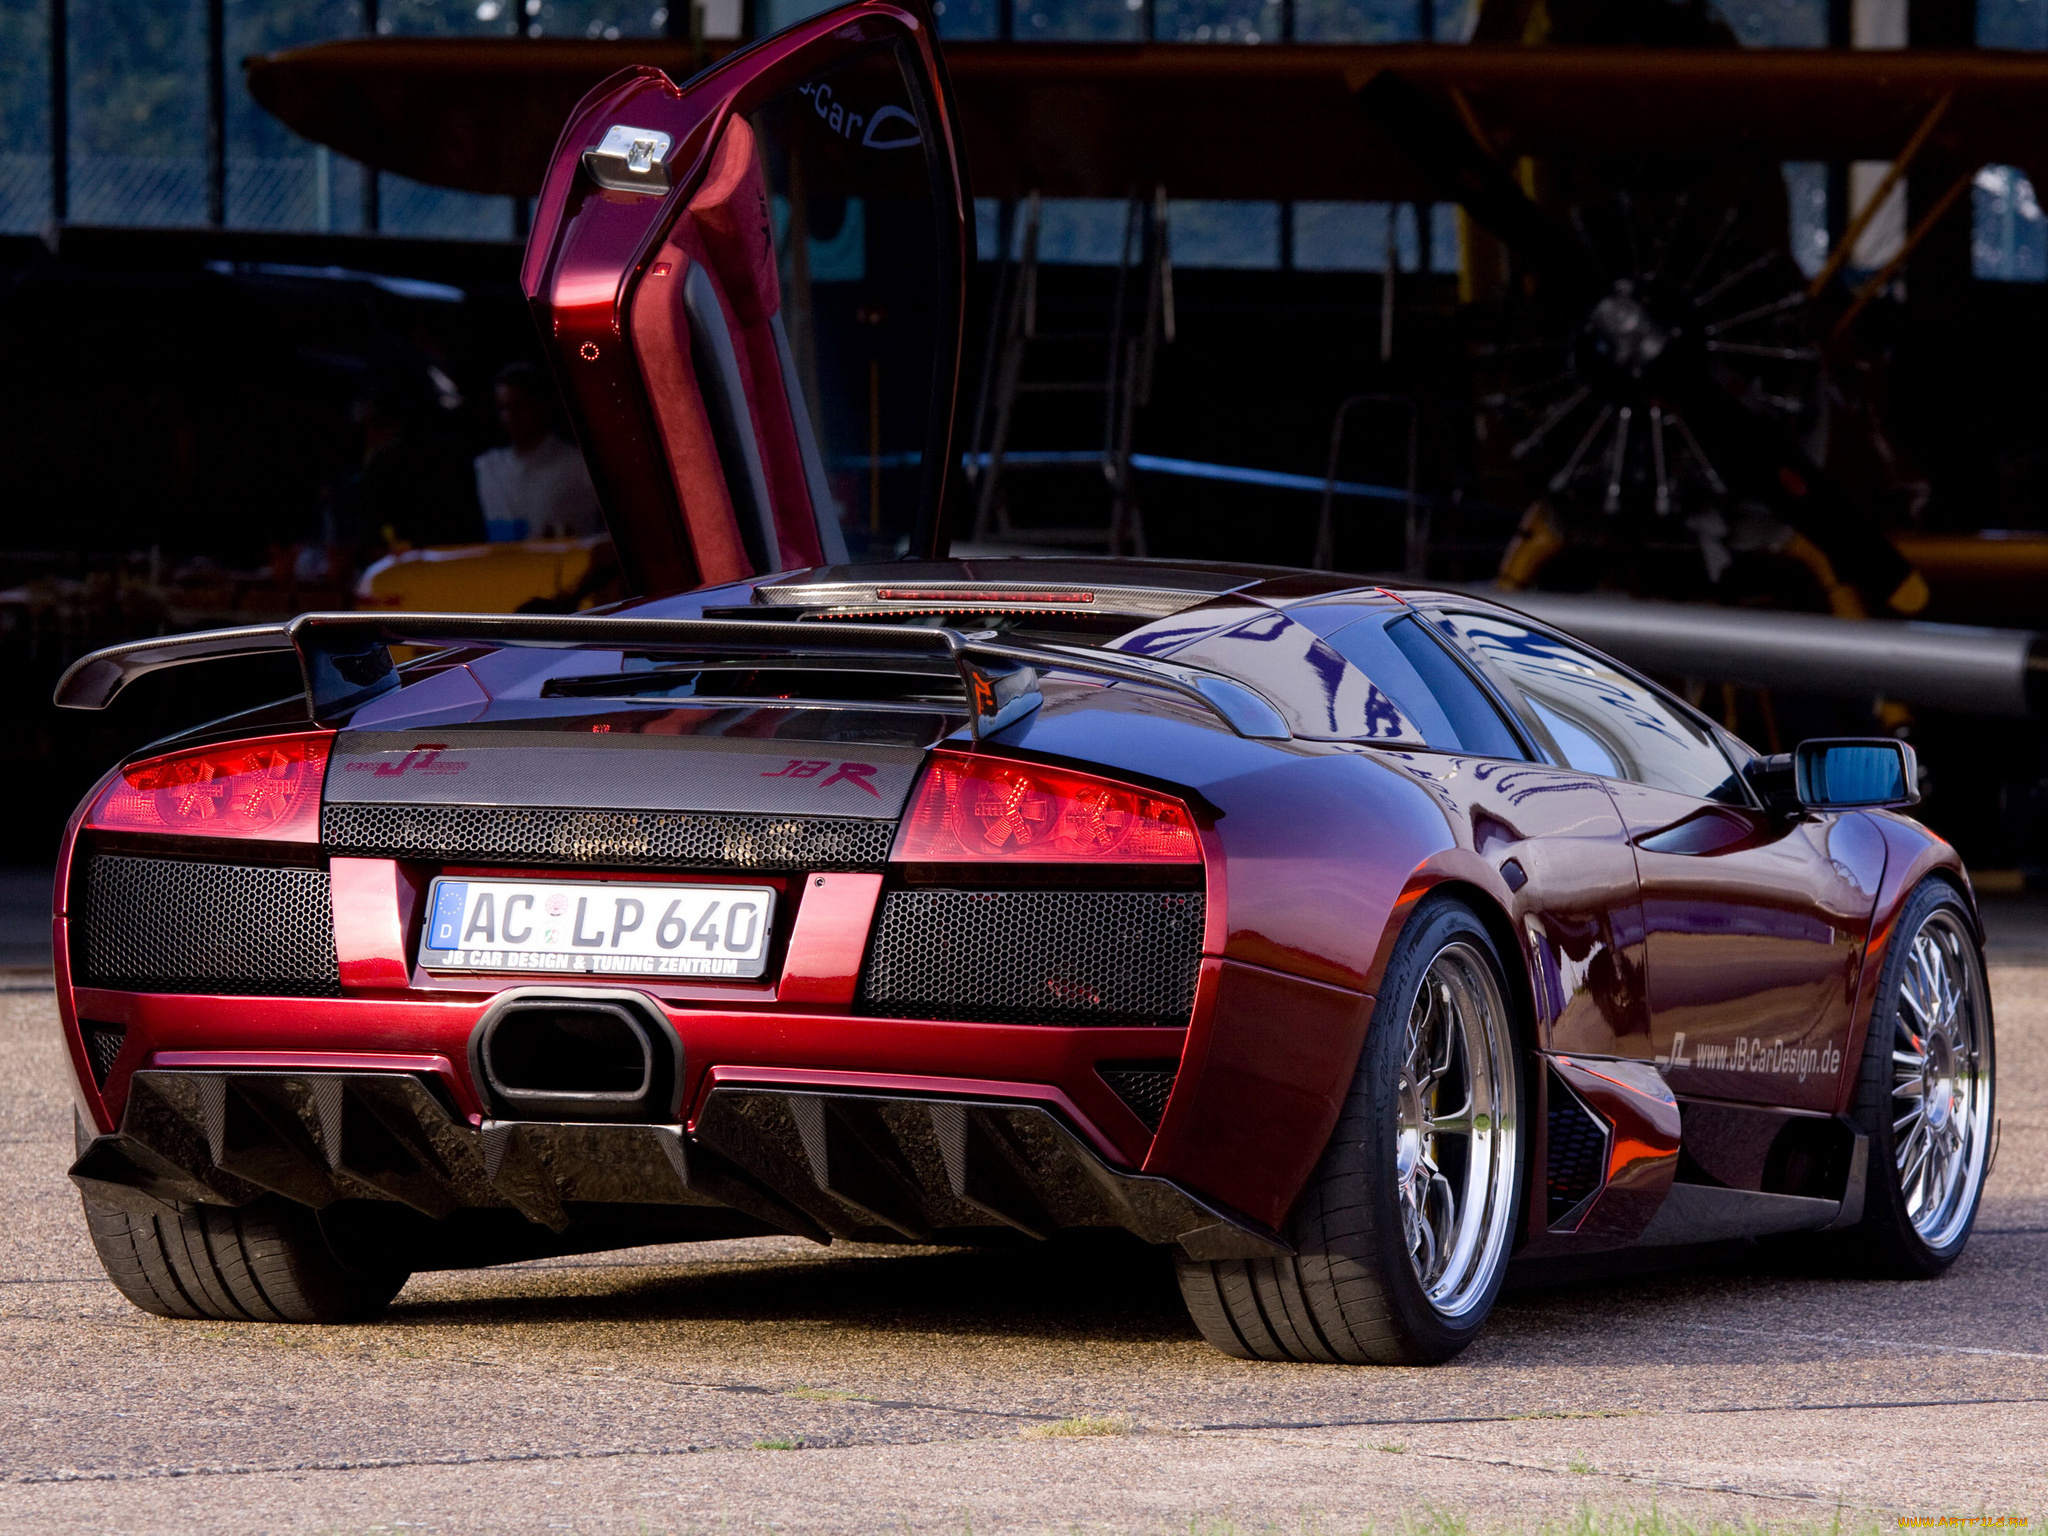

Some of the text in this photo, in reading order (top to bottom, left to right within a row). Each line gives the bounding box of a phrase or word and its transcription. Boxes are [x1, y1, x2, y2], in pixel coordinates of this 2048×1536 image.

[440, 924, 453, 939] D
[463, 893, 758, 953] AC LP 640
[442, 950, 739, 975] JB CAR DESIGN & TUNING ZENTRUM
[1697, 1037, 1841, 1083] www.JB-CarDesign.de
